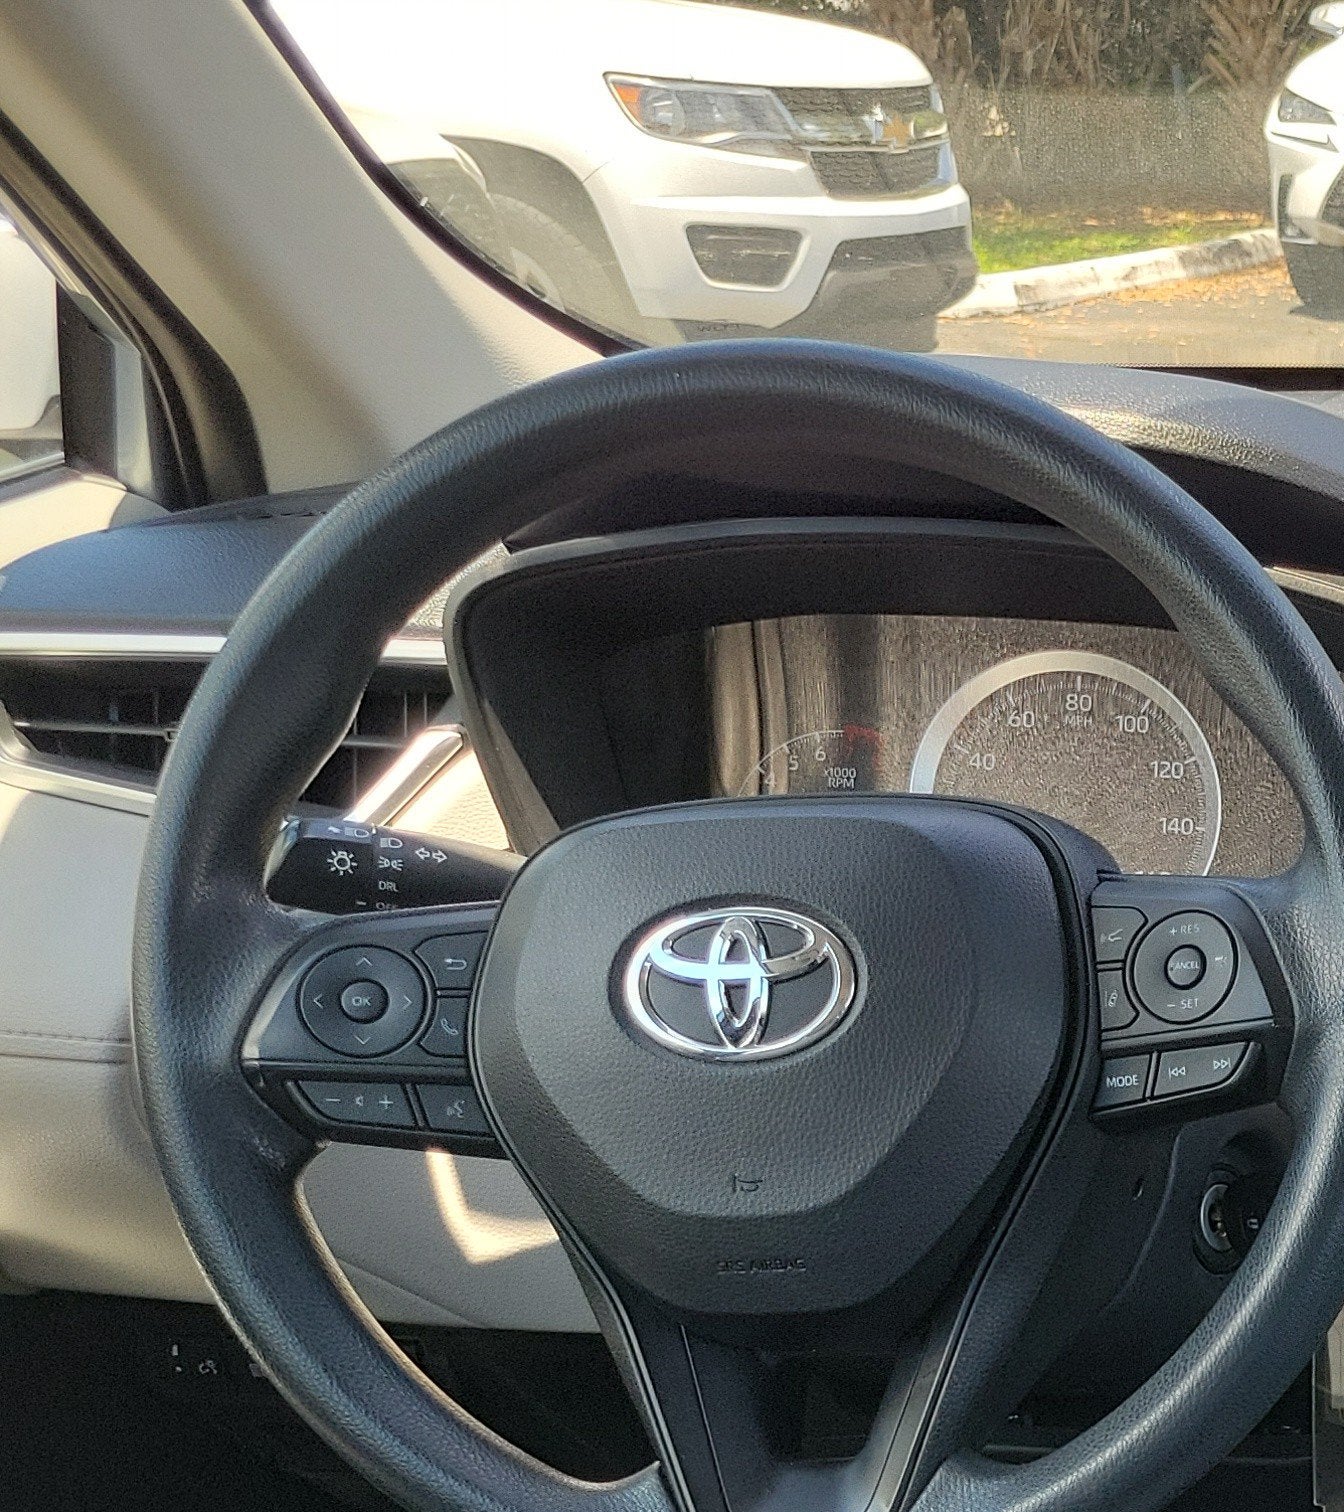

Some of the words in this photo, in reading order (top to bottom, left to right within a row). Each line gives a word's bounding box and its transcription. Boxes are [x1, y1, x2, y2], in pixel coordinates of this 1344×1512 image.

[1065, 694, 1093, 712] 80
[1007, 711, 1035, 728] 60
[1063, 716, 1093, 728] MPH
[1115, 715, 1150, 734] 100
[816, 746, 826, 762] 6
[968, 752, 996, 772] 40
[789, 755, 799, 771] 5
[1150, 761, 1184, 780] 120
[764, 772, 776, 787] 4
[828, 778, 856, 789] RPM
[1159, 817, 1194, 836] 140
[378, 880, 399, 892] DRL
[352, 996, 371, 1007] OK
[1180, 999, 1200, 1010] SET
[1105, 1074, 1139, 1088] MODE
